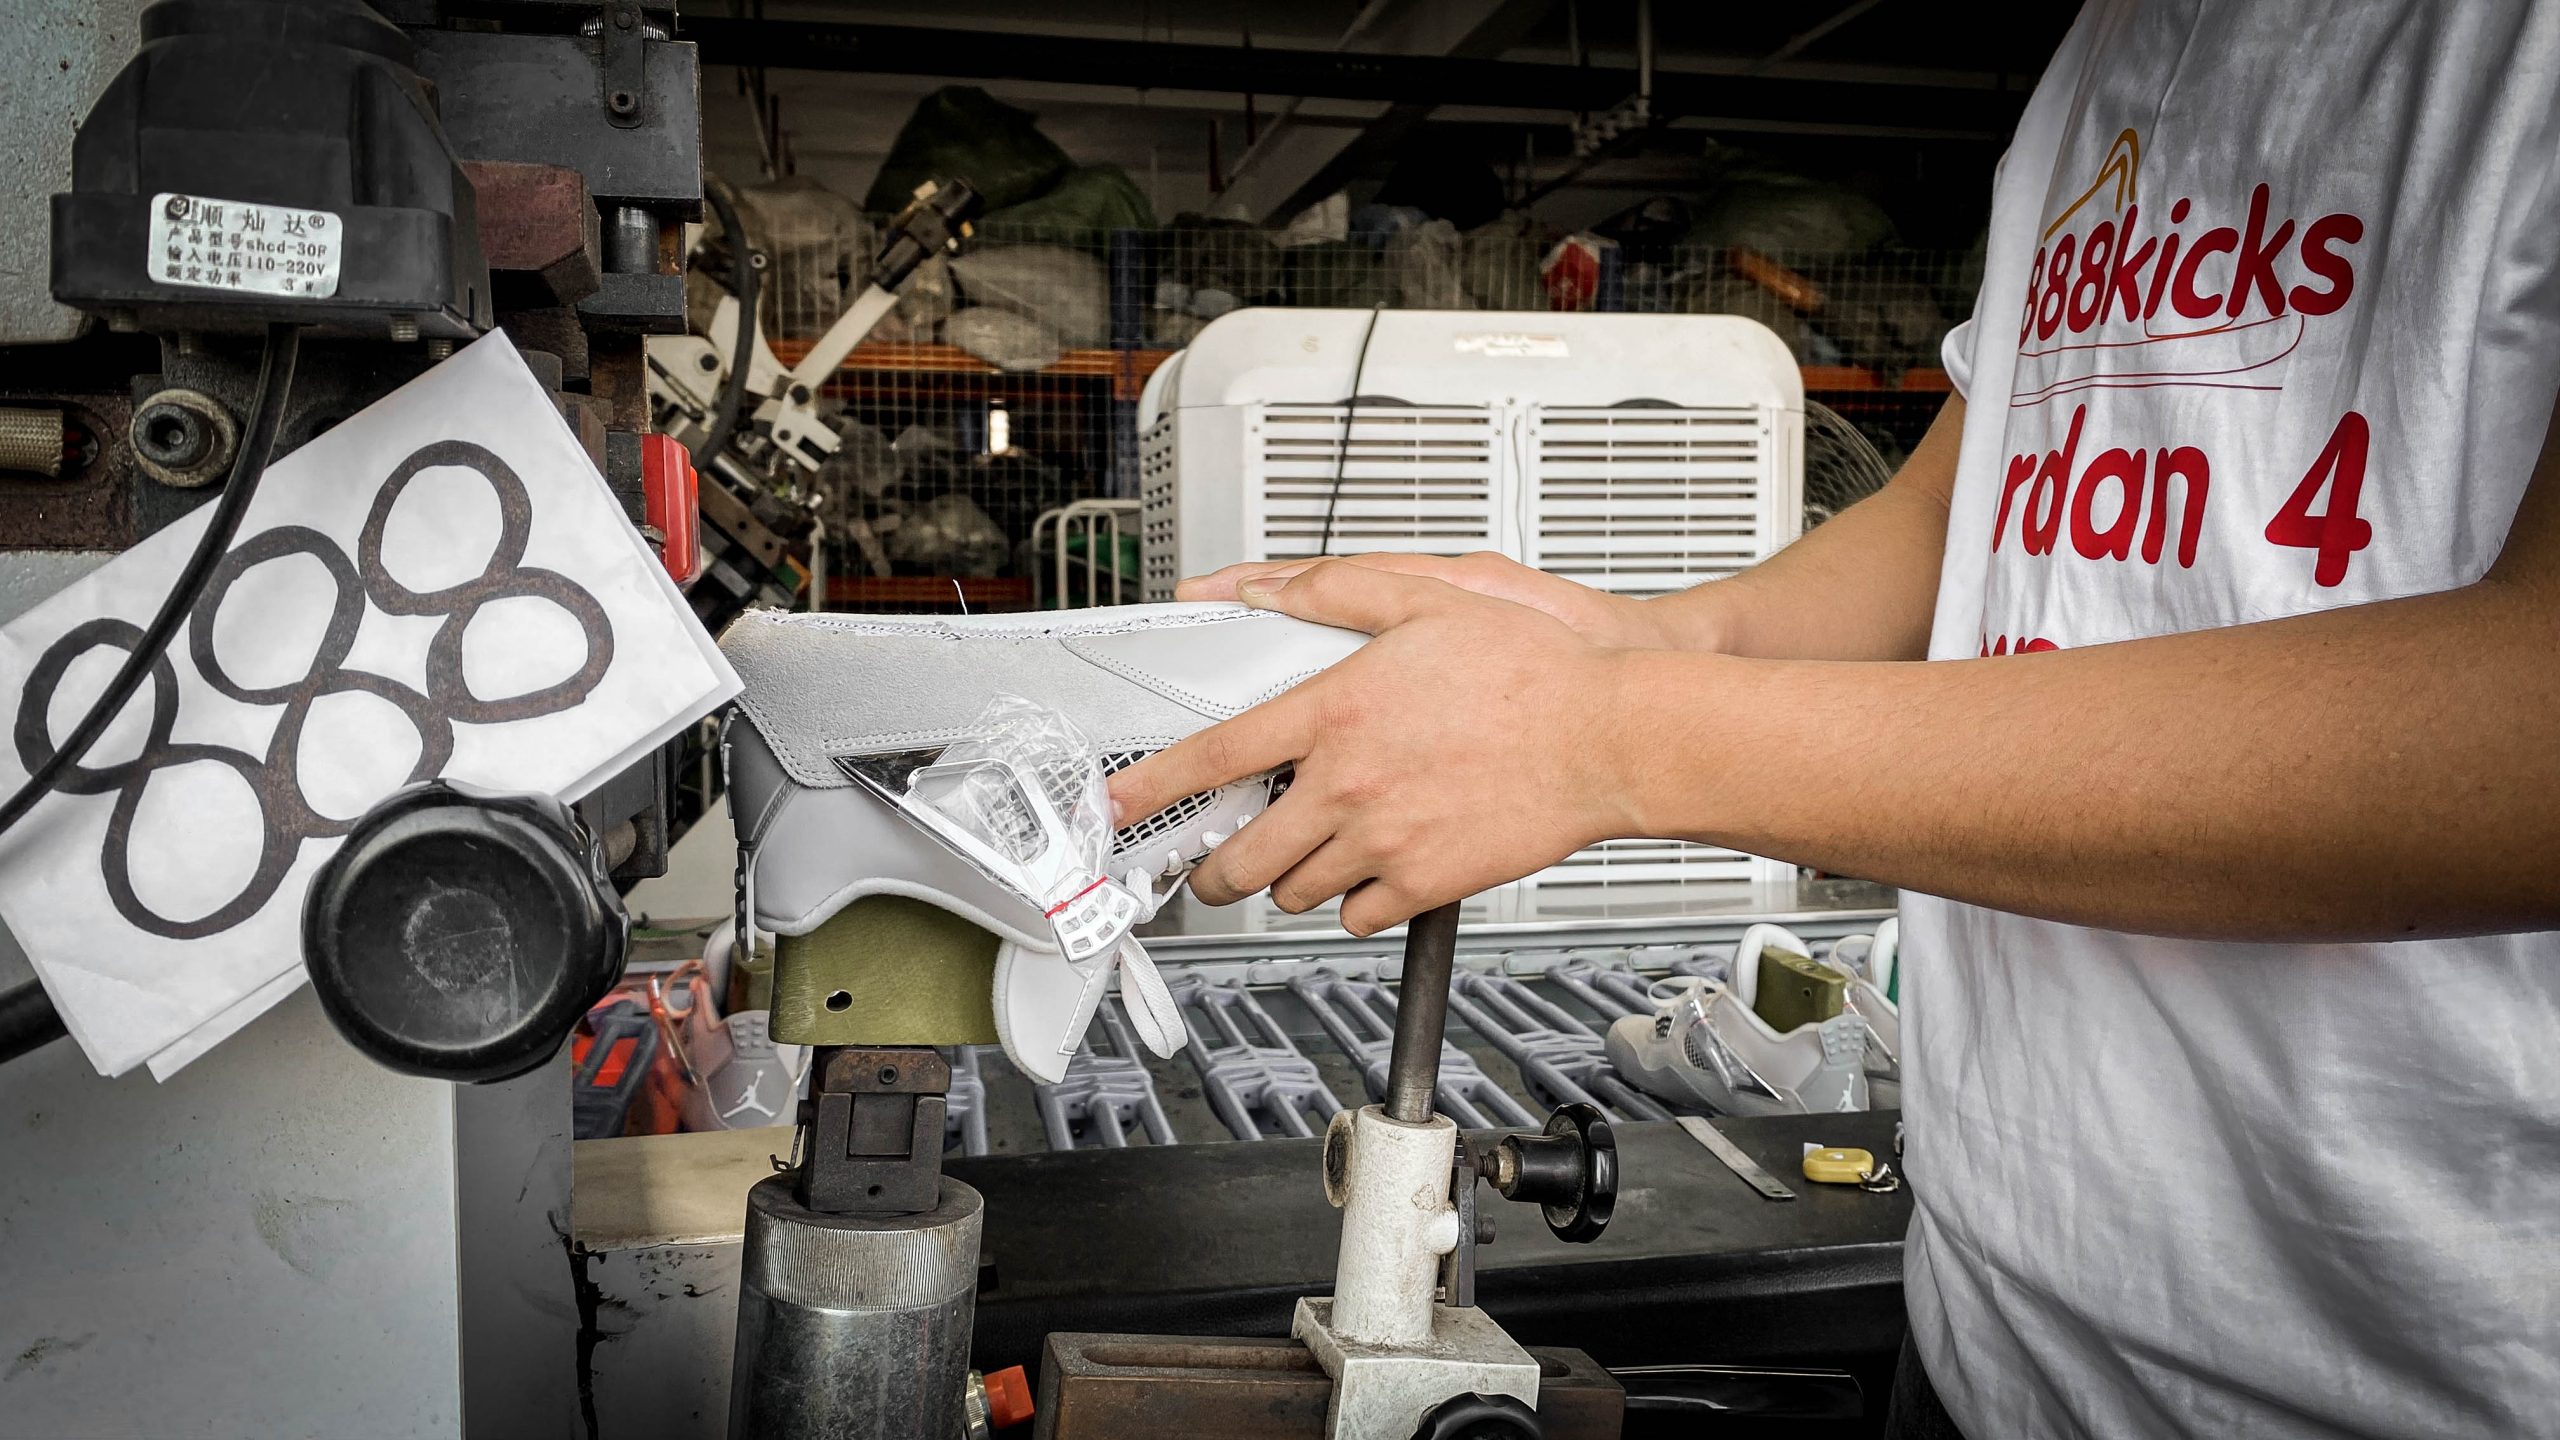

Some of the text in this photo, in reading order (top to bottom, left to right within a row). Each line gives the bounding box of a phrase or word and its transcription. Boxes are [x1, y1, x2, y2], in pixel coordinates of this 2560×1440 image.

[166, 264, 241, 288] 额定功率
[167, 226, 243, 250] 产品型号
[246, 256, 326, 277] 110-220V
[2019, 182, 2364, 348] 888kicks
[2264, 411, 2373, 588] 4
[13, 439, 614, 940] 888
